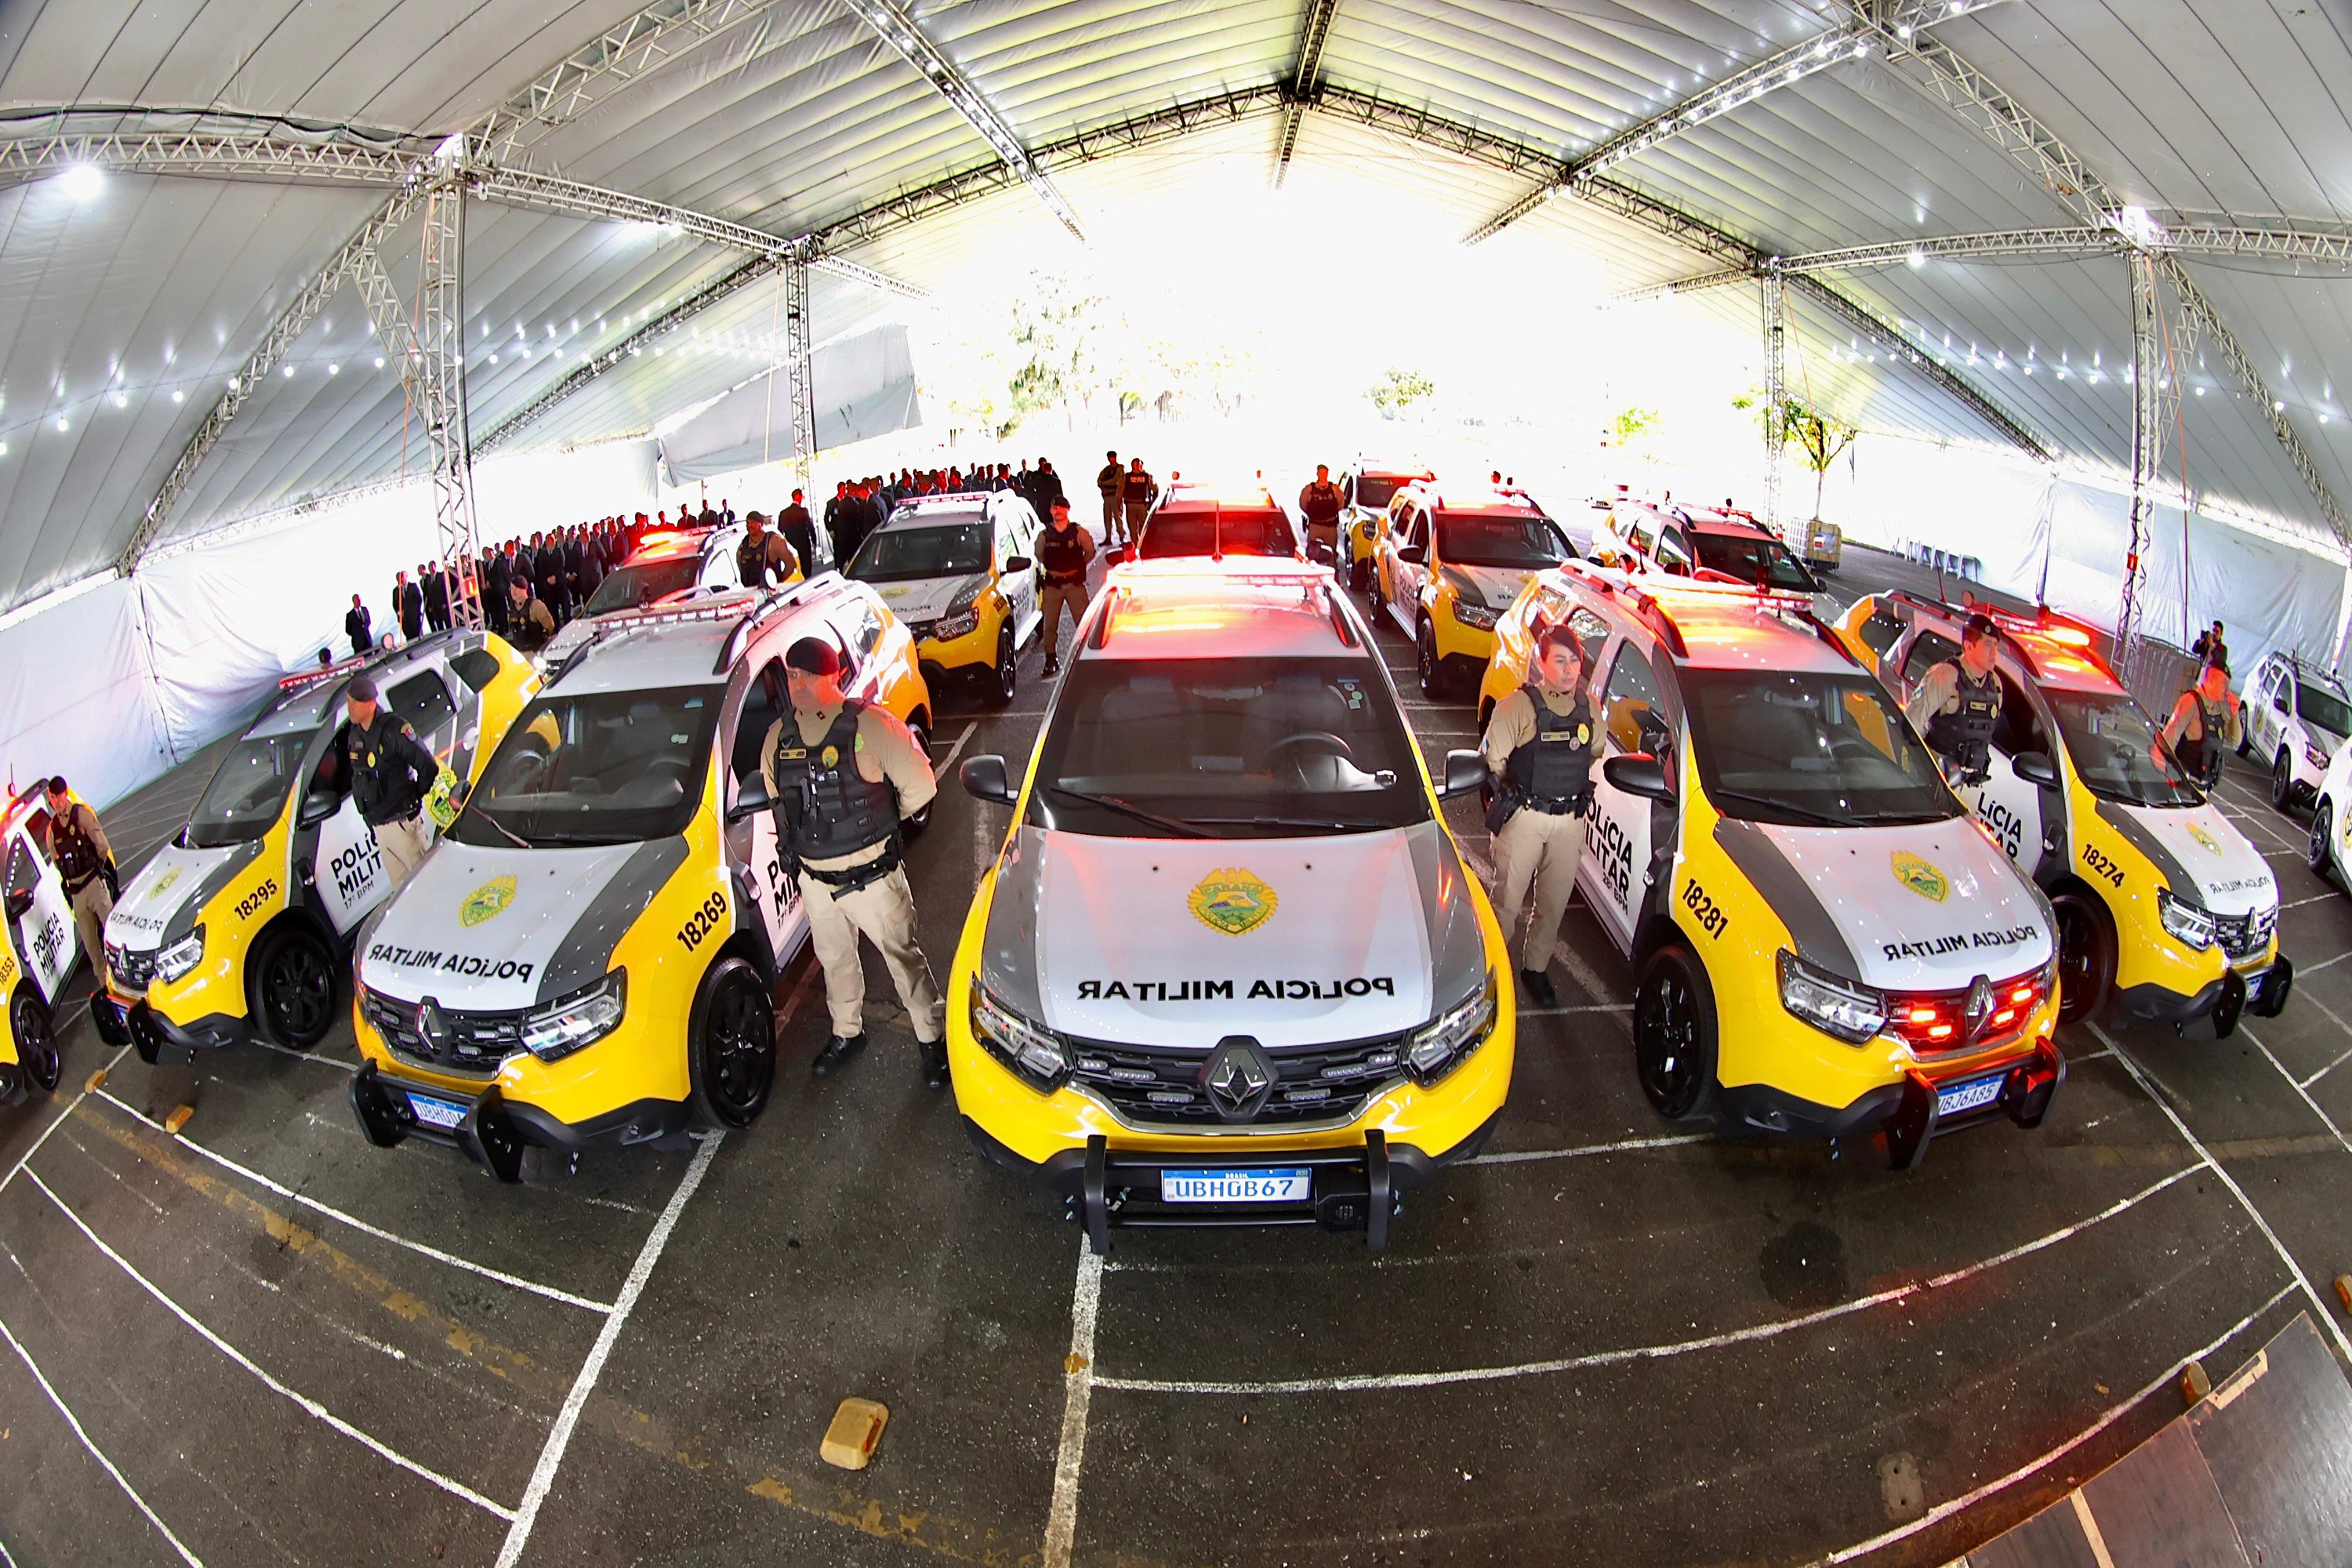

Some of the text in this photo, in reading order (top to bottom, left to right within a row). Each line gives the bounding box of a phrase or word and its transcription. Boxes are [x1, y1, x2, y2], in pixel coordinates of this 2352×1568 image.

[1586, 796, 1632, 874] OLÍCIA
[1977, 791, 2022, 844] LÍCIA
[330, 833, 378, 880] POLÍC
[338, 849, 381, 900] MILIT
[1586, 822, 1629, 901] ILITAR
[2082, 844, 2125, 888] 18274
[234, 879, 278, 920] 18295
[677, 891, 727, 953] 18269
[1682, 878, 1729, 941] 18281
